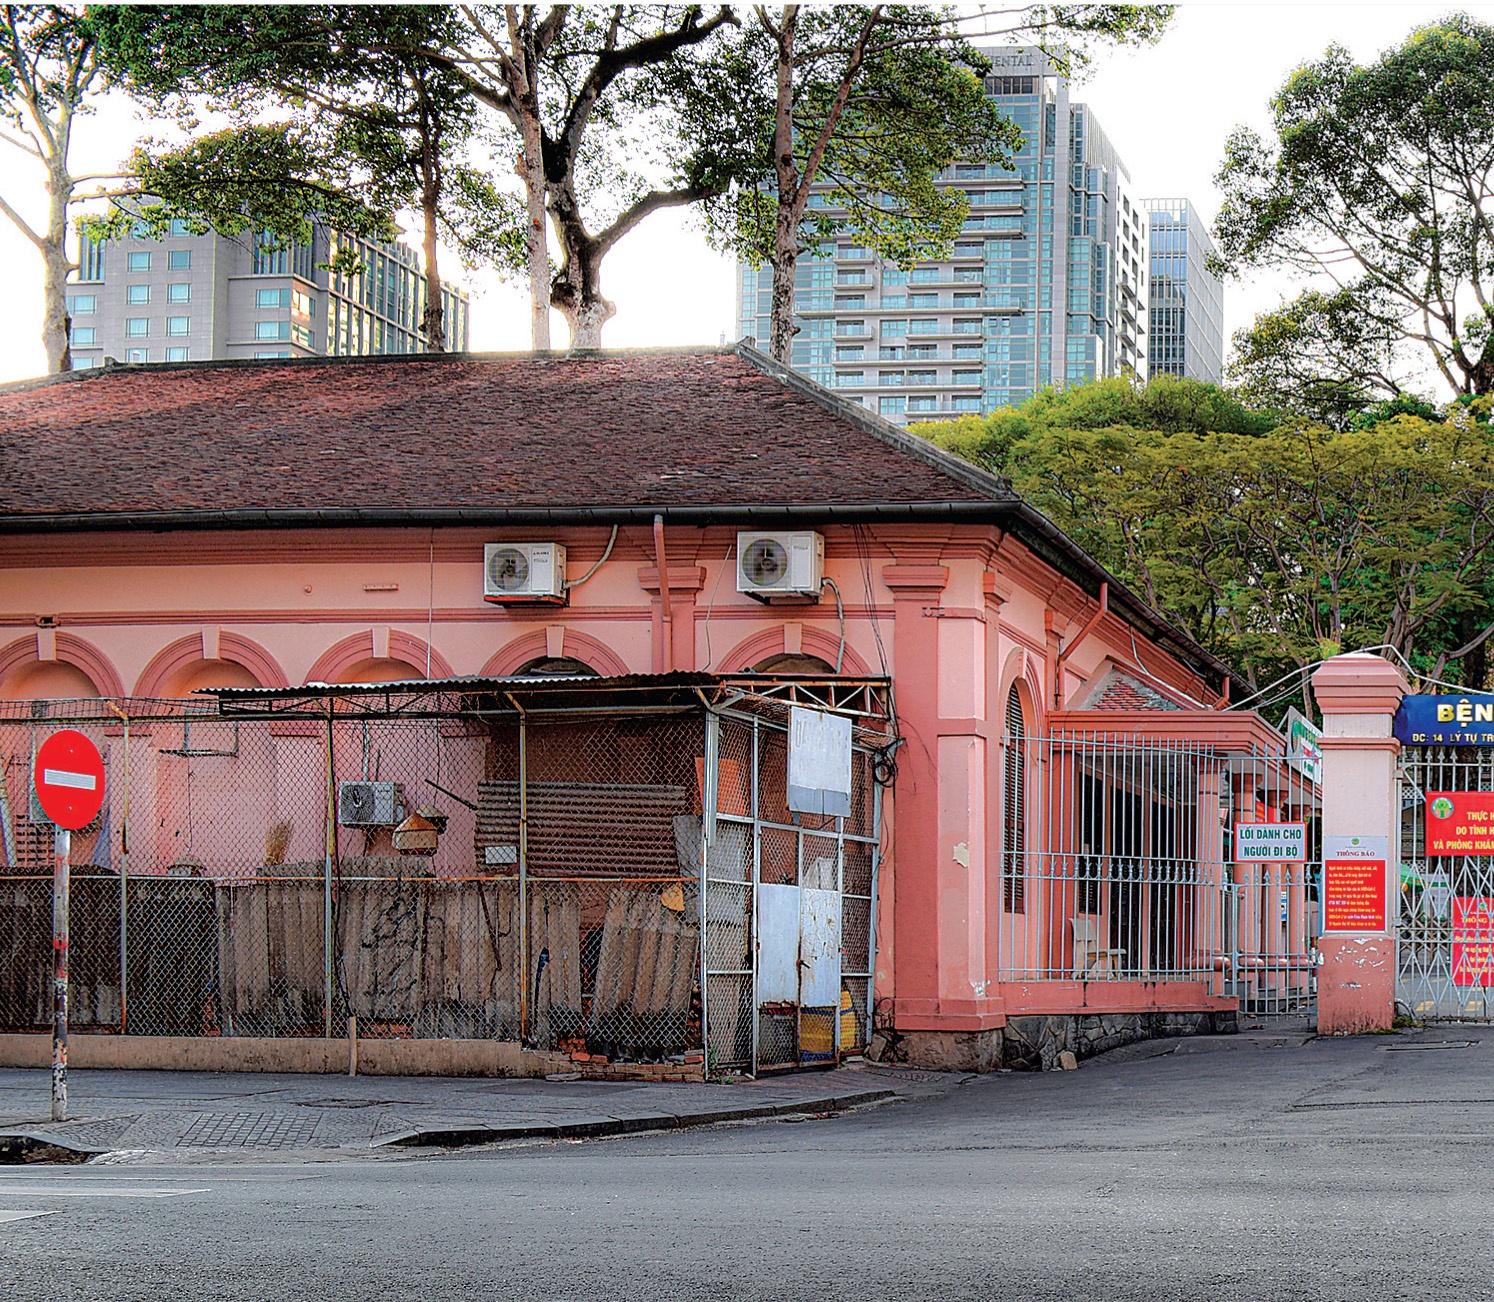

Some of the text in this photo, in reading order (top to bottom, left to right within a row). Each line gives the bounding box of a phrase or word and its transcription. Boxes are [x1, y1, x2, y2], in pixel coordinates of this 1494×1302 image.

[990, 55, 1031, 67] ENTAL
[1412, 733, 1430, 743] ĐC:
[1433, 733, 1443, 743] 14
[1450, 730, 1462, 742] LÝ
[1464, 733, 1478, 745] TỰ
[1467, 811, 1488, 822] THỰC
[1239, 825, 1302, 840] LỐI DÀNH CHO
[1456, 826, 1467, 835] DO
[1469, 824, 1487, 835] TÌNH
[1433, 838, 1444, 850] VÀ
[1446, 838, 1473, 850] PHÒNG
[1243, 844, 1298, 858] NGƯỜI ĐI BỘ
